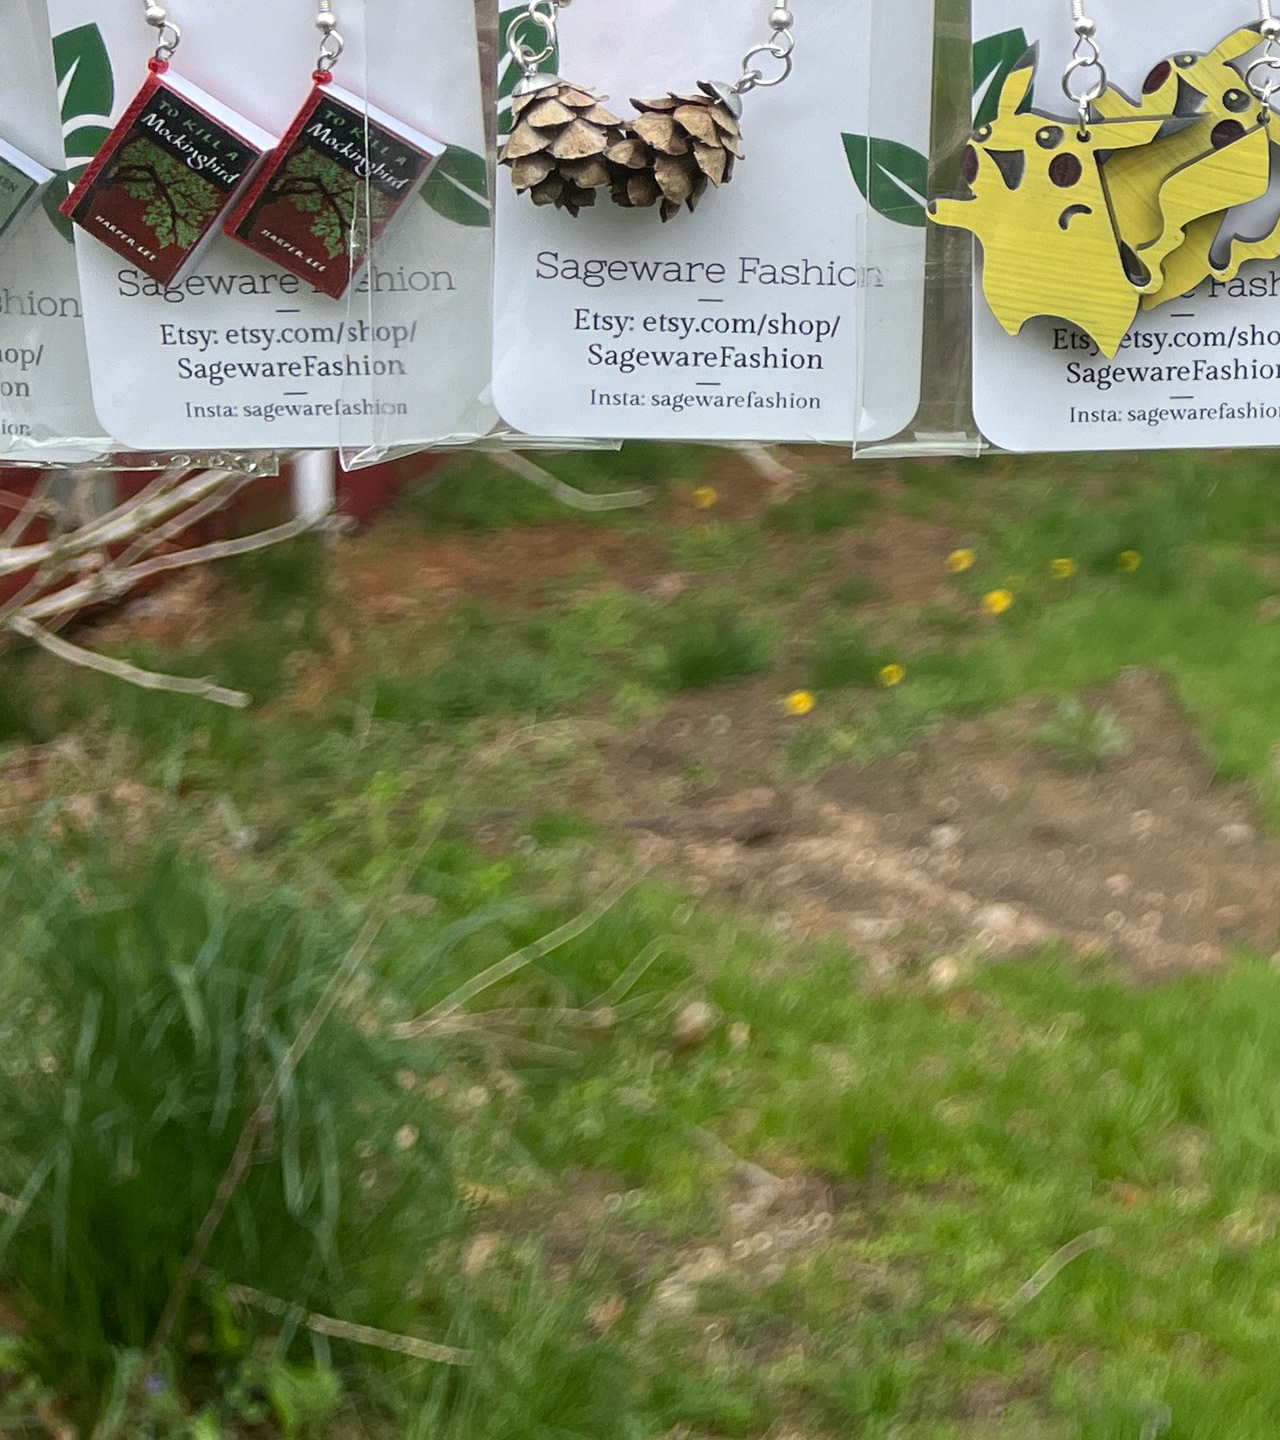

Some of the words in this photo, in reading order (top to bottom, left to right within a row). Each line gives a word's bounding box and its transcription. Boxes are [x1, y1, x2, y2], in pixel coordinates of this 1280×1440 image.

[159, 100, 180, 118] TO
[183, 119, 221, 150] KILL
[225, 151, 239, 161] A
[325, 110, 345, 126] TO
[141, 113, 240, 185] Mockingbird
[307, 123, 410, 190] Mockingbird
[95, 215, 135, 246] HARPER
[261, 229, 304, 258] HARPER
[535, 251, 726, 287] Sageware
[738, 257, 884, 288] Fashion
[0, 287, 82, 318] hion
[160, 324, 219, 351] Etsy:
[226, 320, 417, 345] etsy.com/shop/
[574, 308, 635, 339] Etsy:
[643, 312, 840, 342] etsy.com/shop/
[178, 355, 406, 385] SagewareFashion
[588, 343, 824, 374] SagewareFashion
[186, 401, 239, 418] Insta:
[243, 399, 407, 422] sagewarefashion
[590, 389, 645, 408] Insta:
[651, 389, 821, 411] sagewarefashion
[1070, 406, 1122, 424] Insta:
